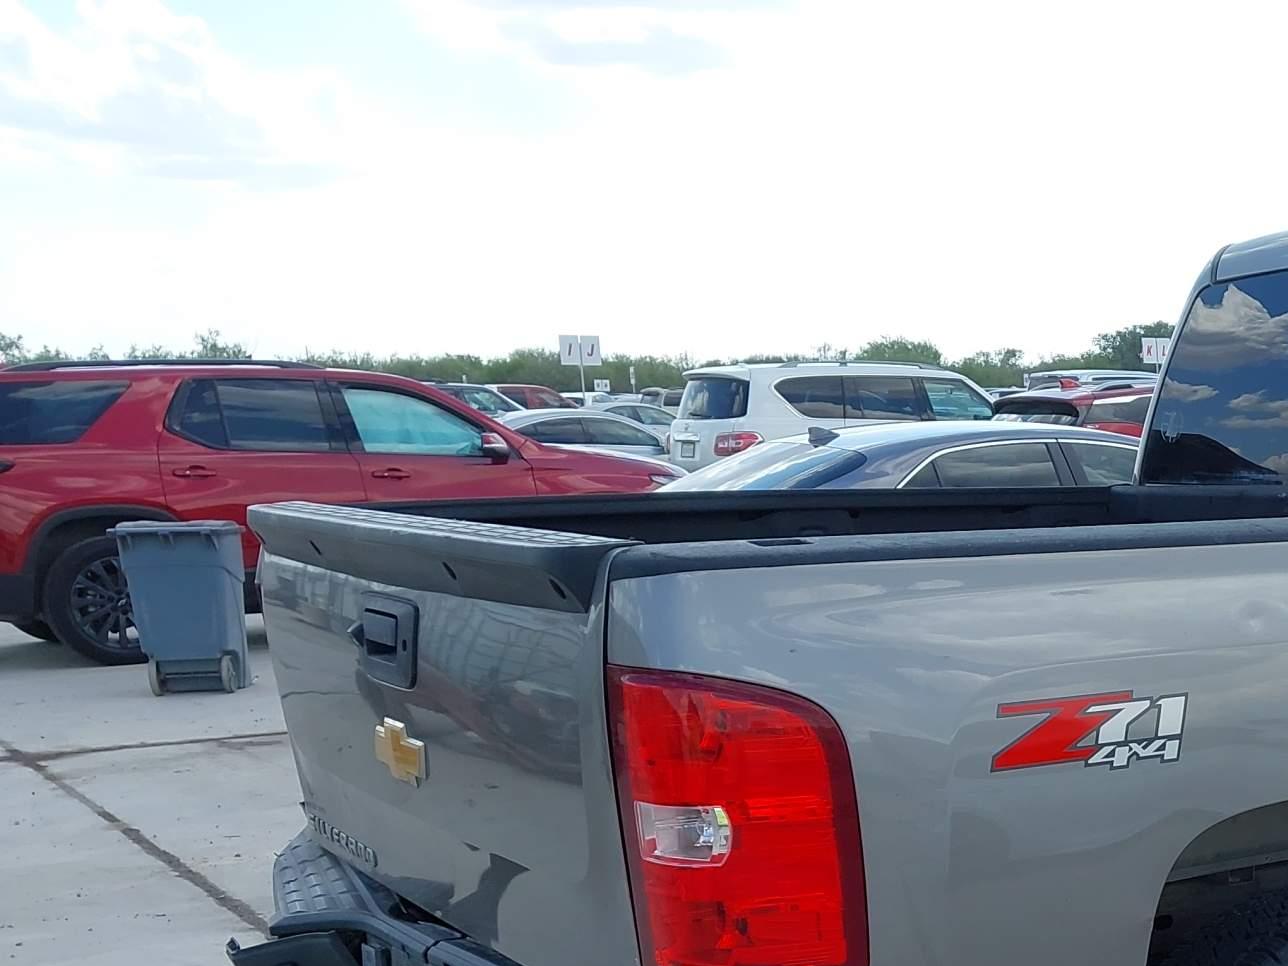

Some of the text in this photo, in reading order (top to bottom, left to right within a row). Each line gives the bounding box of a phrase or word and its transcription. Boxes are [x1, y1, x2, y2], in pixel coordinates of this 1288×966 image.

[587, 343, 595, 357] J
[1146, 344, 1153, 357] K
[990, 690, 1188, 772] Z71
